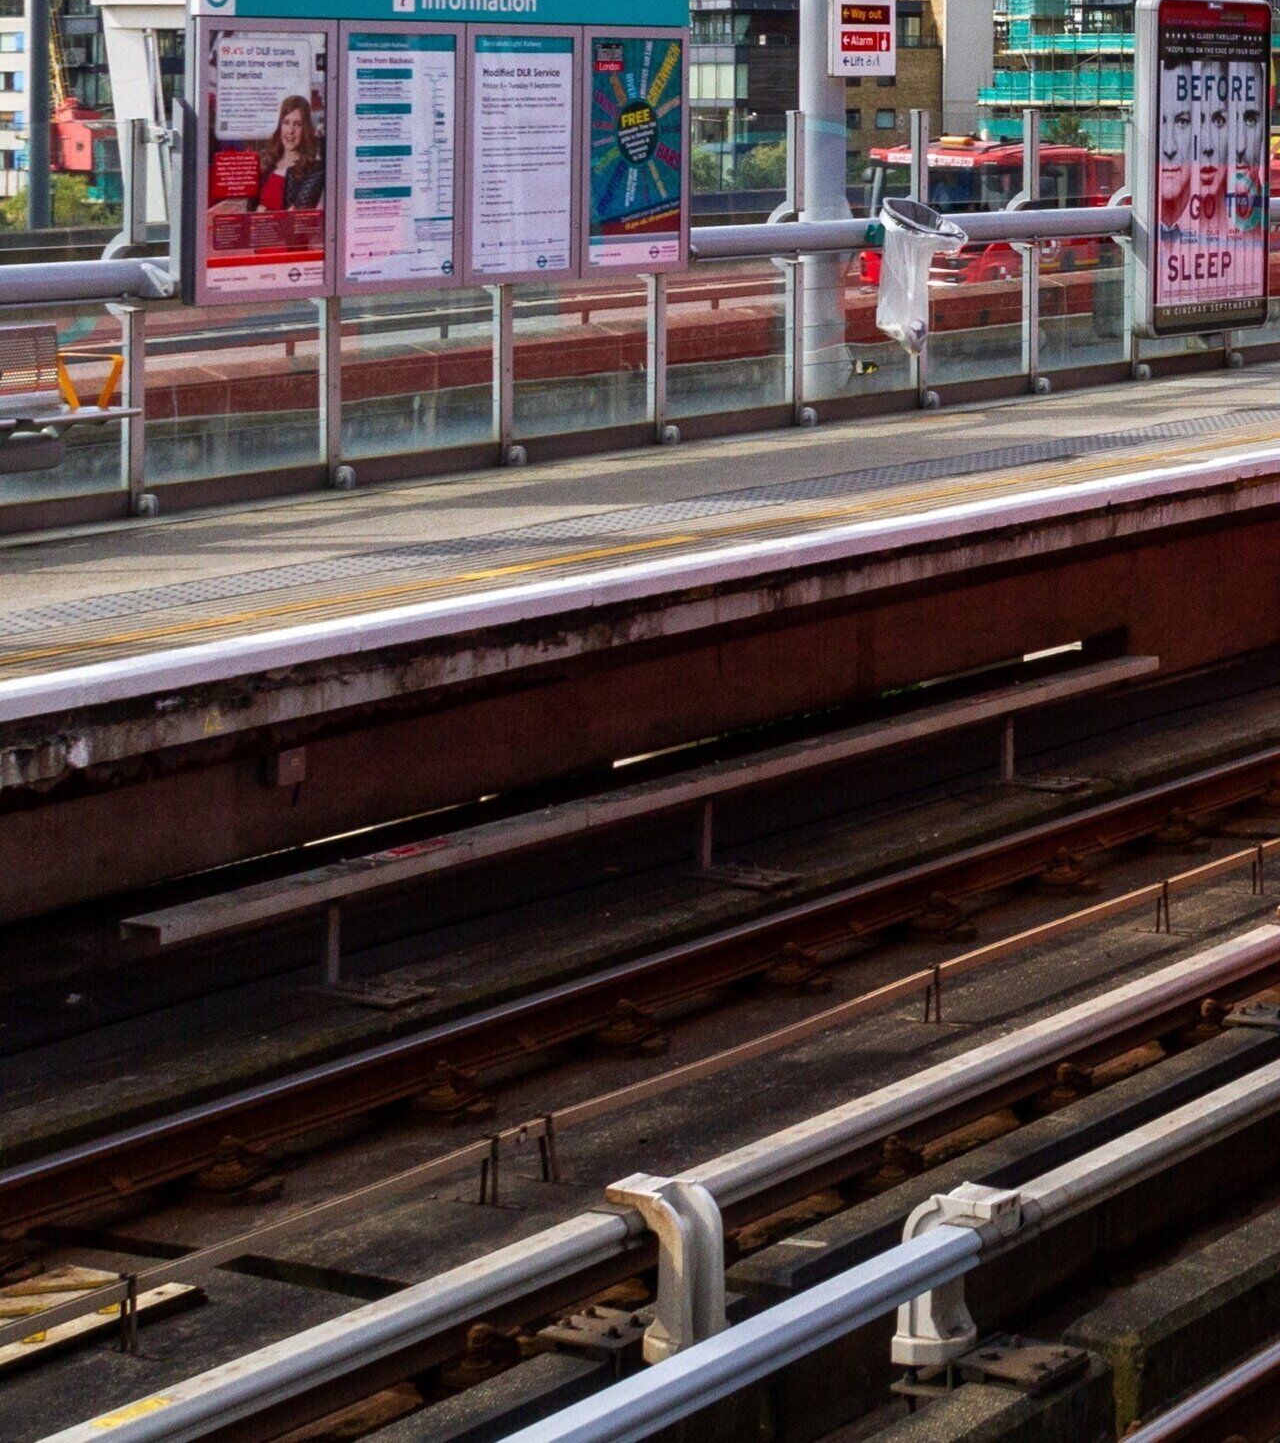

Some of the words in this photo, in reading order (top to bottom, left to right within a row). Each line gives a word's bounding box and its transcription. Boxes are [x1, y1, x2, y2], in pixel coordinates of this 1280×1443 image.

[850, 8, 867, 21] Way
[868, 9, 883, 20] out
[850, 35, 874, 46] Alarm
[599, 62, 620, 71] London
[850, 56, 864, 67] Lift
[482, 68, 515, 77] Modified
[516, 68, 532, 77] DLR
[533, 68, 560, 77] Service
[1176, 74, 1256, 102] BEFORE
[620, 108, 651, 128] FREE
[1189, 193, 1216, 221] GO
[1167, 250, 1233, 283] SLEEP
[1173, 304, 1207, 316] CINEMAS
[1209, 301, 1251, 313] SEPTEMBER
